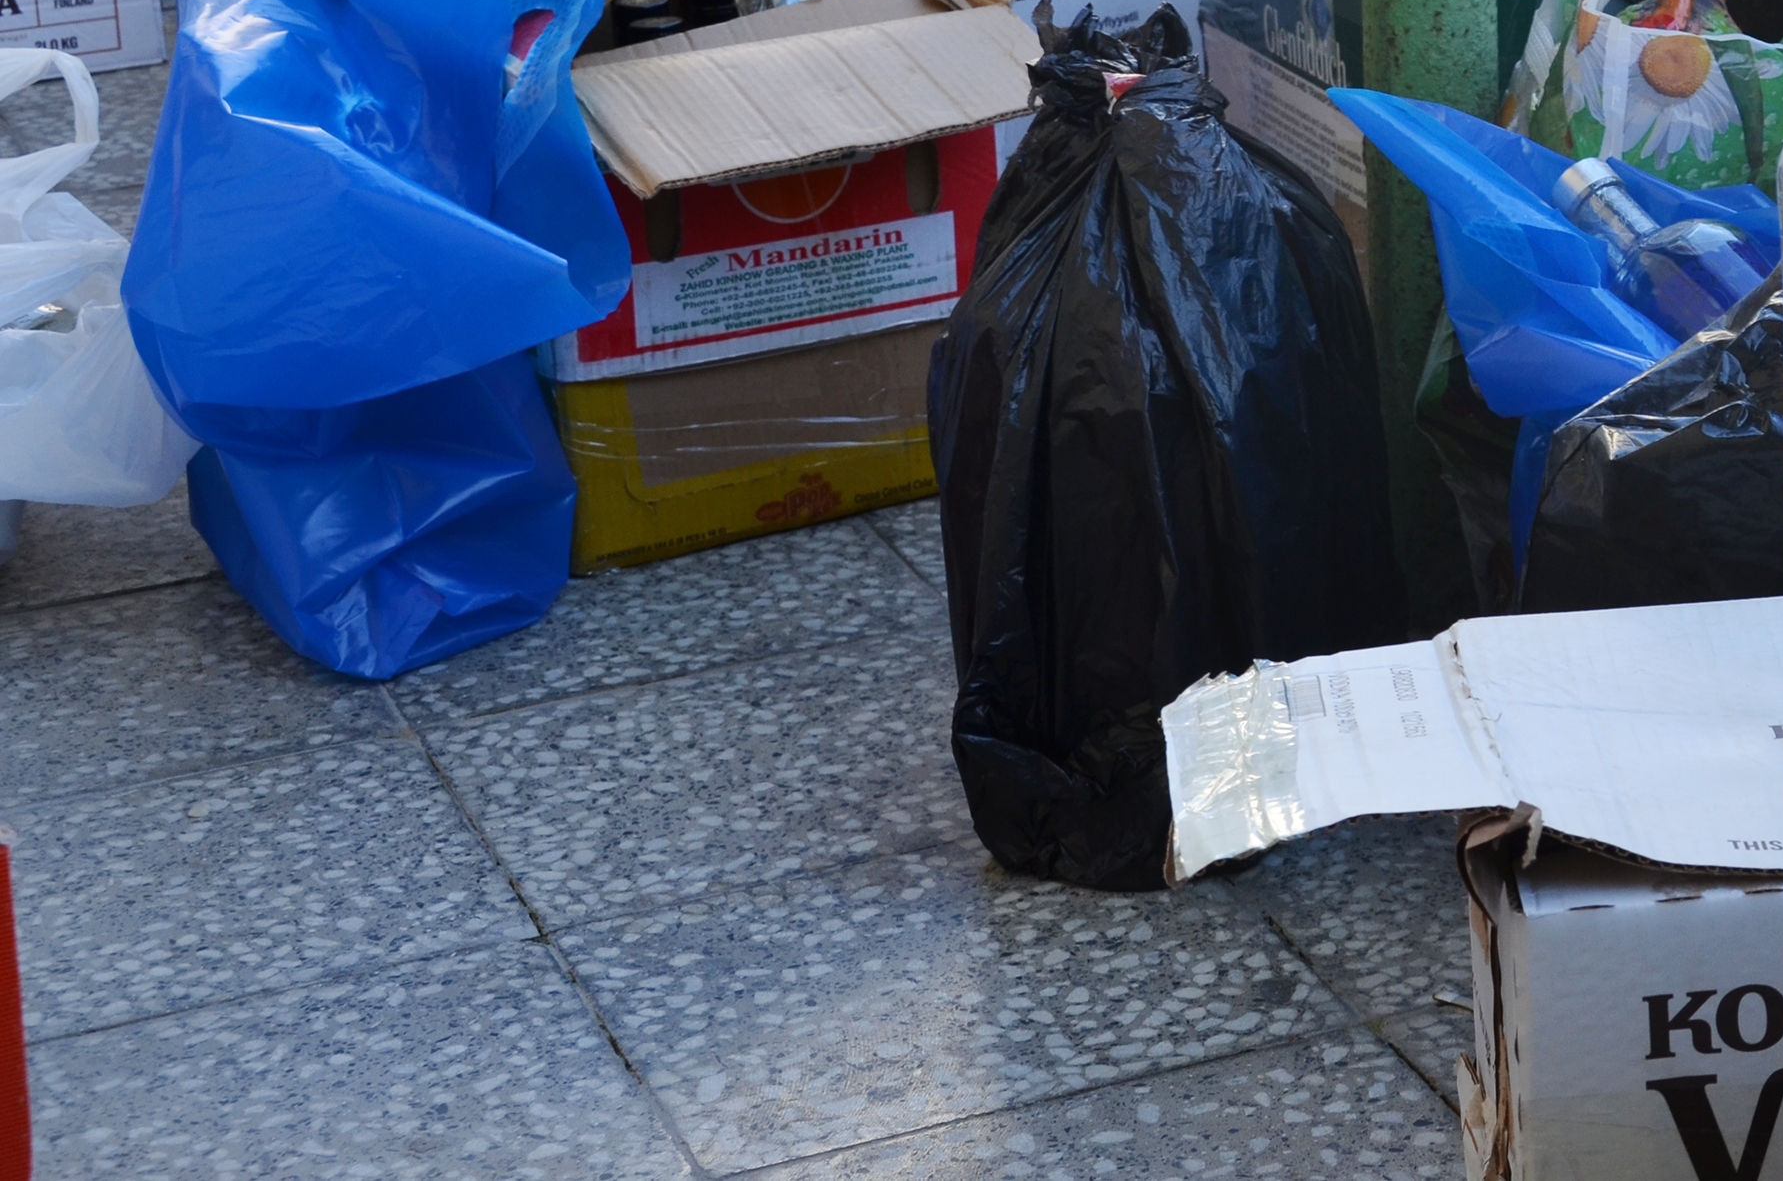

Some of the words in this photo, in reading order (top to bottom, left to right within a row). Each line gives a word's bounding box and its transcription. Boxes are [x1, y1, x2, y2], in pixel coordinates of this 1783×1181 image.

[62, 36, 78, 49] KG
[1264, 4, 1347, 88] Glenfiddich
[680, 278, 714, 292] ZAHID
[716, 270, 763, 286] KINNOW
[765, 260, 818, 278] GRADING
[830, 249, 875, 265] WAXING
[877, 242, 909, 257] PLANT
[685, 254, 720, 279] Fresh
[725, 228, 904, 273] Mandarin
[1728, 839, 1783, 852] THIS
